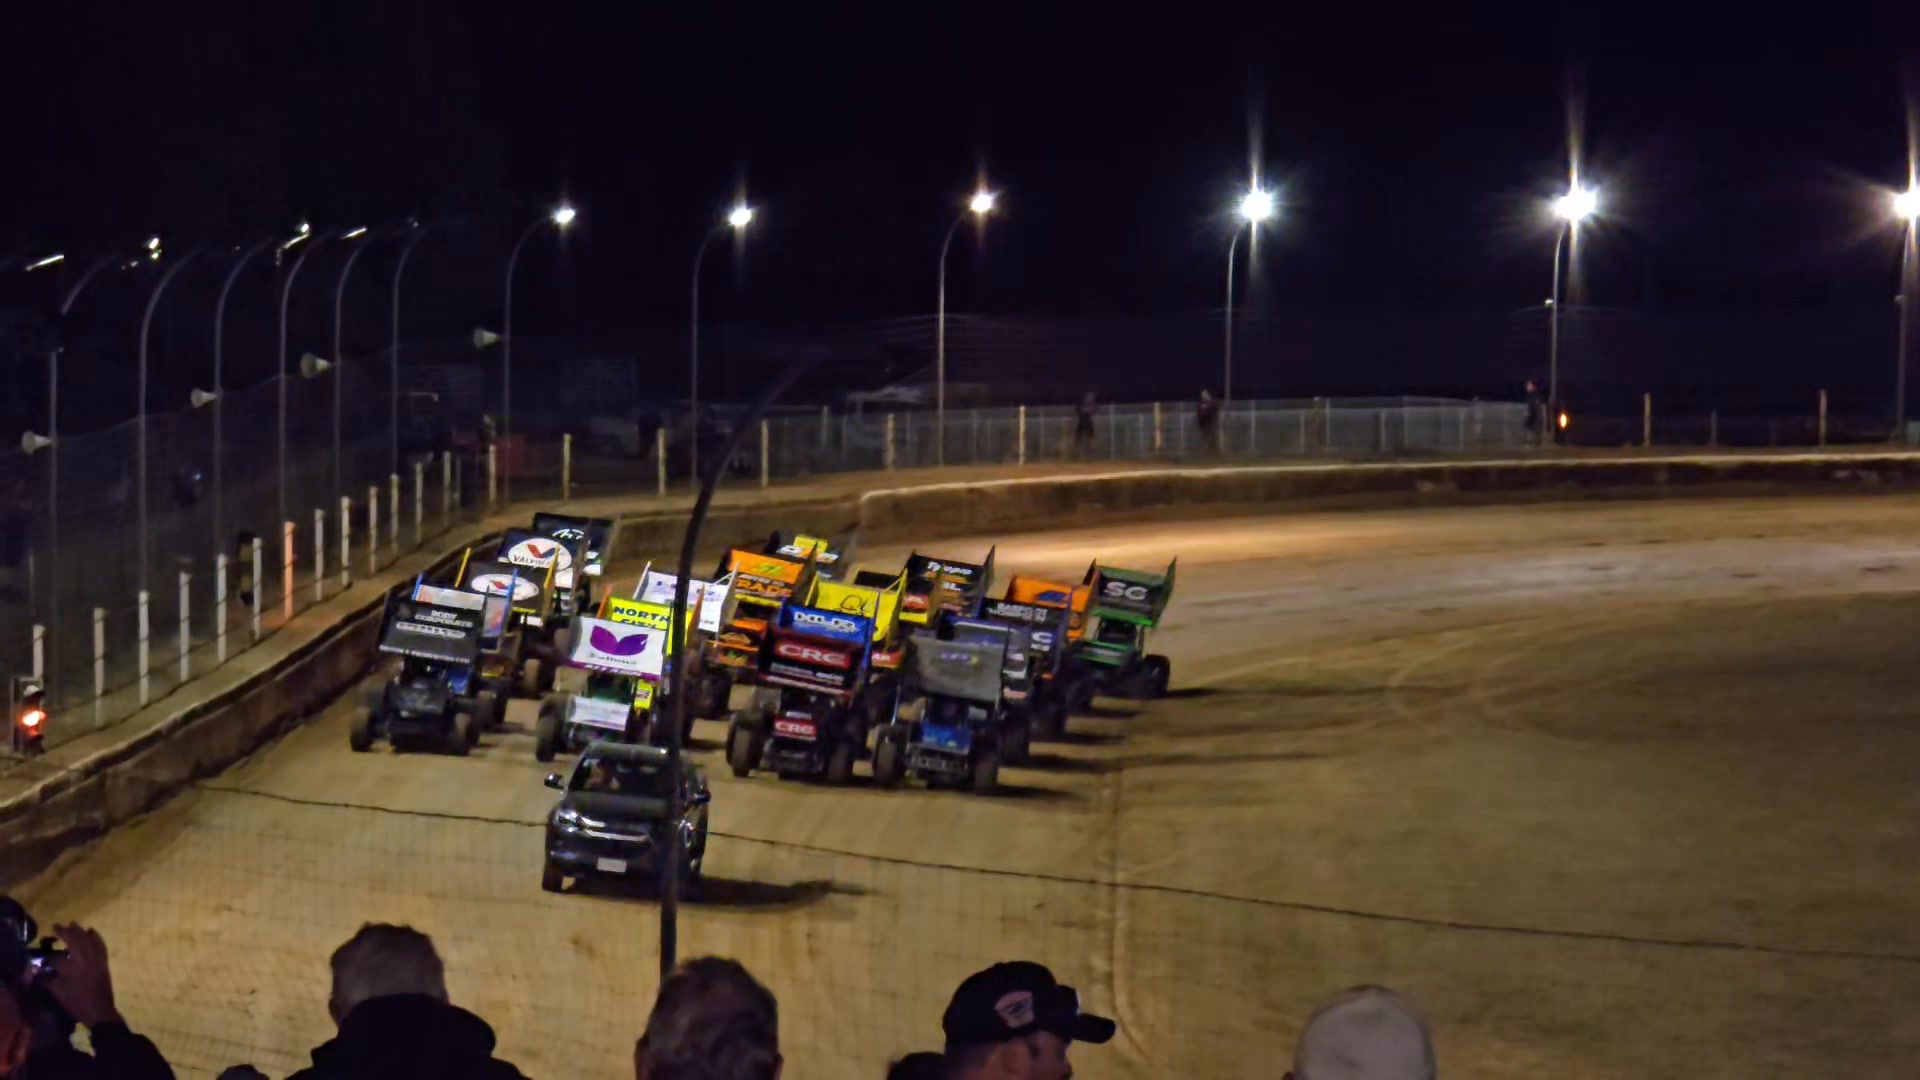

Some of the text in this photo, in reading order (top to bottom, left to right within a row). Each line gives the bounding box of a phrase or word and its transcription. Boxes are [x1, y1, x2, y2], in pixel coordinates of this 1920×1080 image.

[614, 606, 670, 623] NORTH
[778, 644, 845, 665] CRC
[775, 722, 814, 734] CRC
